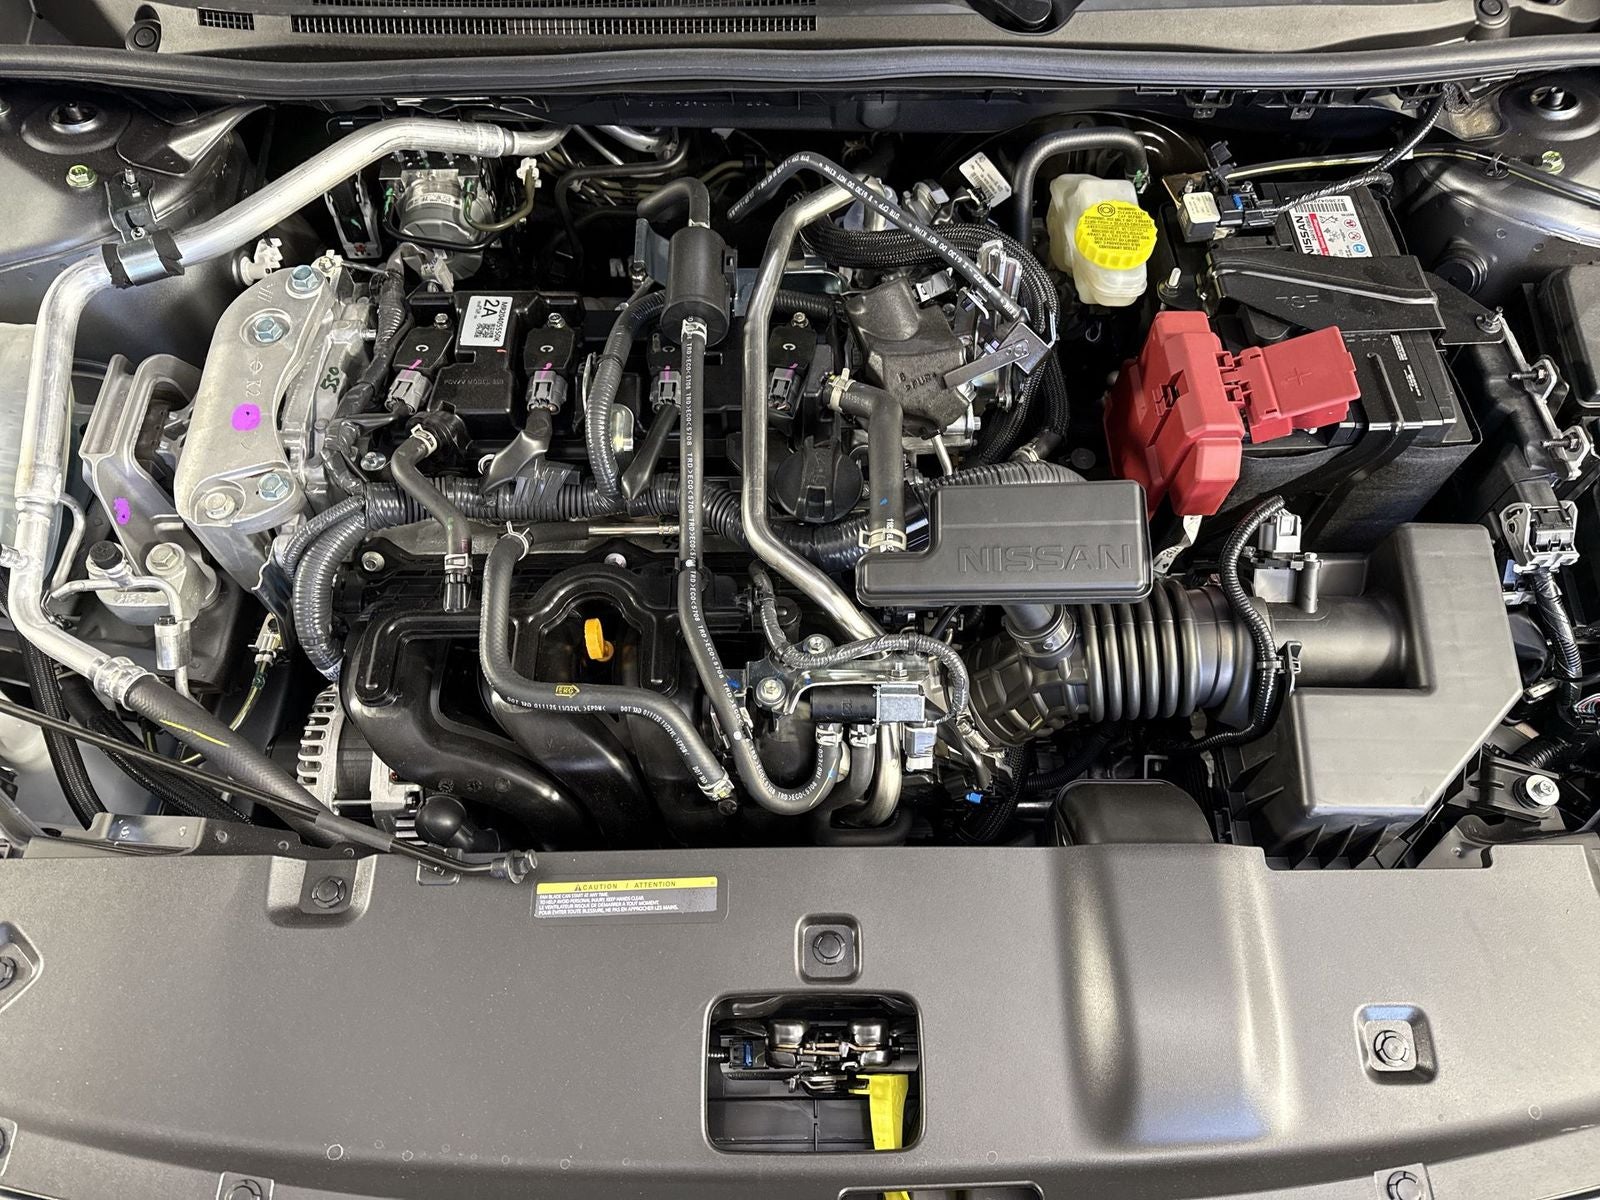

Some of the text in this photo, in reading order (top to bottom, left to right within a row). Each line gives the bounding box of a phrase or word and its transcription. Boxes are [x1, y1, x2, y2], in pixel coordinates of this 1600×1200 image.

[1294, 216, 1314, 254] NISSAN
[481, 299, 500, 317] 2A
[958, 544, 1132, 573] NISSAN
